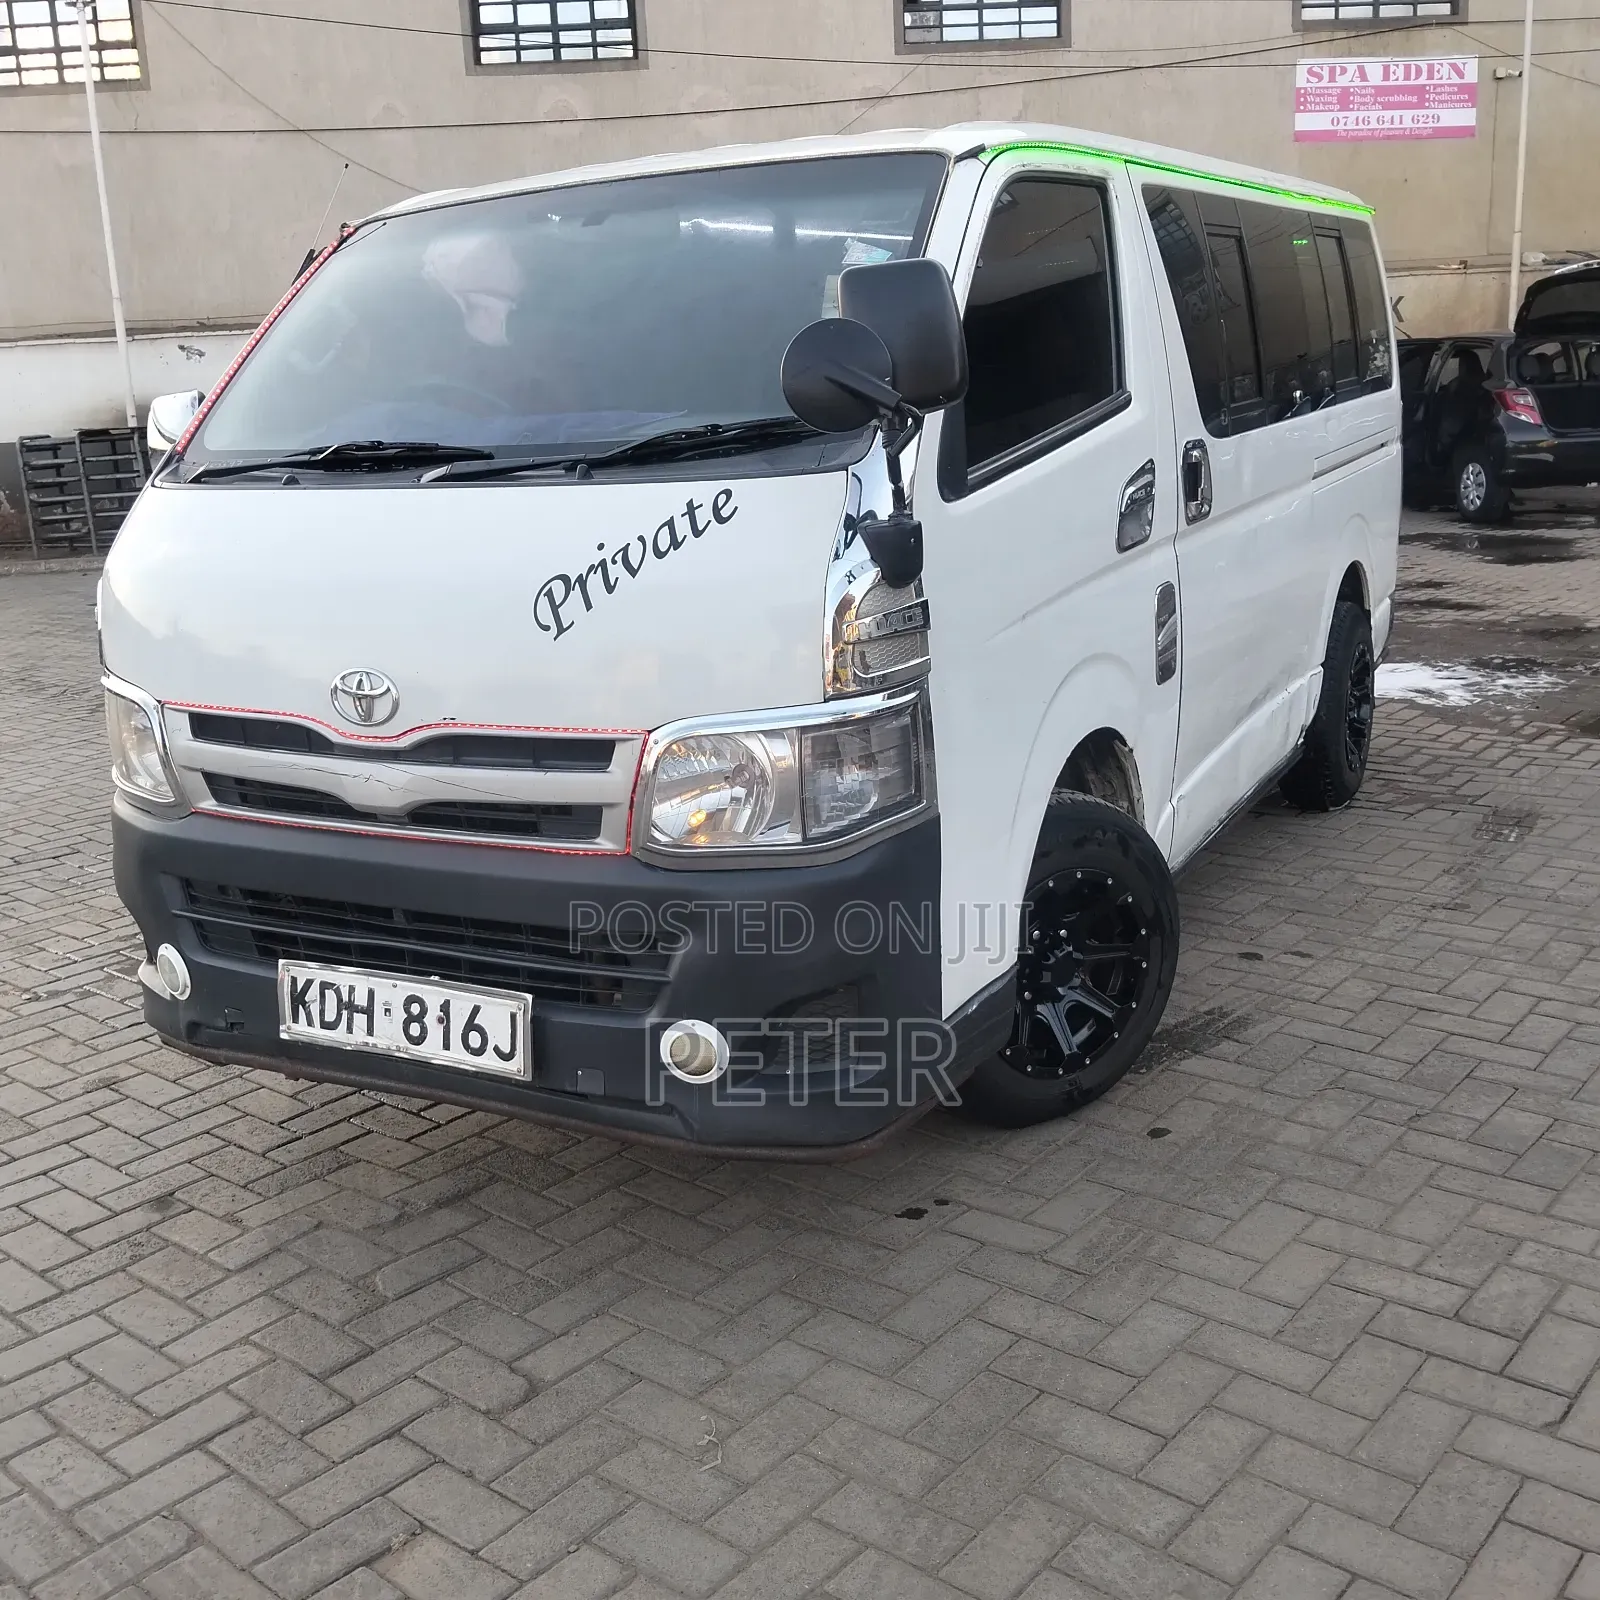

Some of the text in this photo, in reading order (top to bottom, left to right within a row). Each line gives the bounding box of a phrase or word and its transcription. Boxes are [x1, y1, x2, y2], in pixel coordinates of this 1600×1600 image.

[1306, 62, 1468, 84] SPA EDEN
[1306, 87, 1342, 95] Massage
[1306, 95, 1338, 103] Waxing
[1354, 94, 1418, 105] Body scrubbing
[1429, 93, 1469, 101] Pedicures
[1306, 103, 1340, 111] Makeup
[1354, 103, 1382, 111] Facials
[1429, 101, 1472, 109] Manicures
[1330, 113, 1441, 127] 0746 641 629
[1337, 129, 1347, 137] The
[533, 488, 739, 642] Private
[289, 975, 518, 1063] KDH 816J
